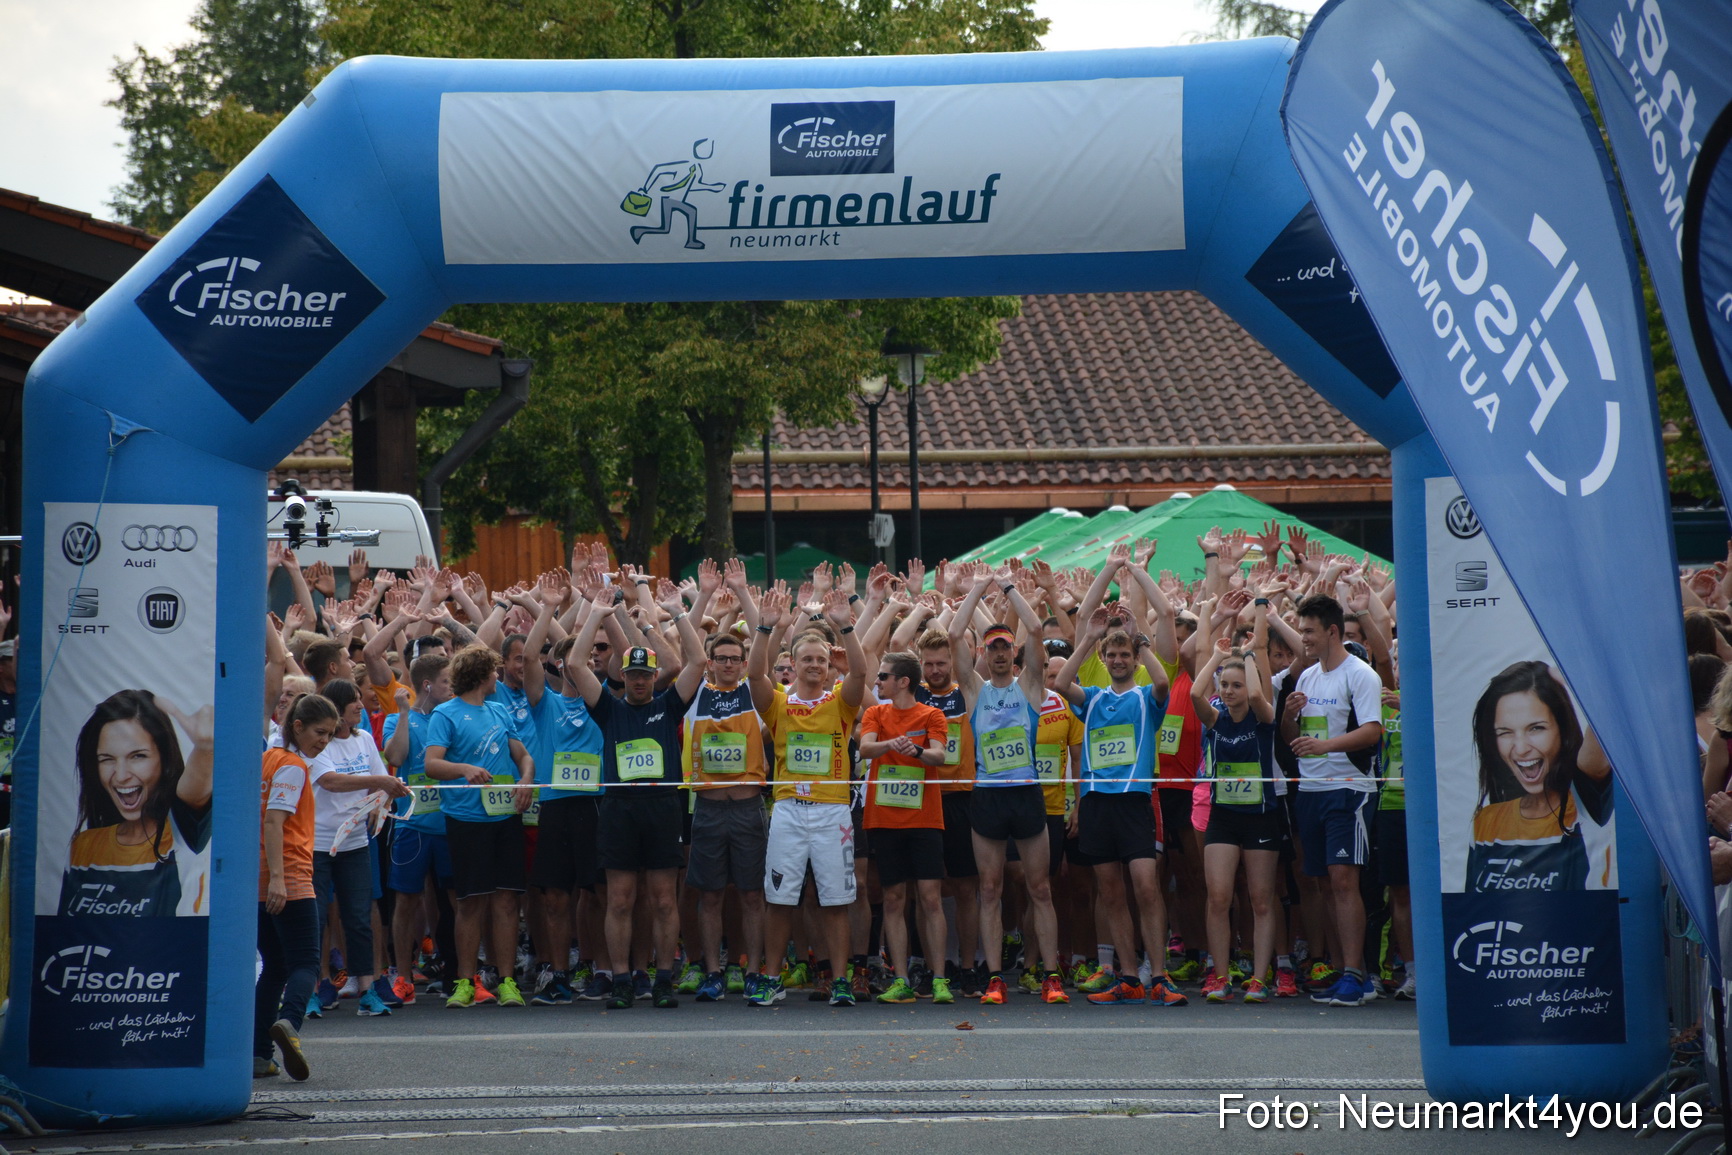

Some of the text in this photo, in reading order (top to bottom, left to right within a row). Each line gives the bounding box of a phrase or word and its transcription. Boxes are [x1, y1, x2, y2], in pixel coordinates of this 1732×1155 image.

[797, 130, 886, 148] Fischer
[805, 148, 879, 159] AUTOMOBILE
[728, 173, 1000, 228] firmenlauf
[729, 230, 841, 248] neumarkt
[1297, 257, 1335, 280] und
[197, 283, 347, 311] Fischer
[209, 314, 334, 328] AUTOMOBILE
[124, 558, 157, 568] Audi
[149, 600, 176, 621] FIAT
[1446, 597, 1500, 608] SEAT
[58, 624, 110, 634] SEAT
[787, 708, 812, 717] MAX
[705, 748, 742, 763] 1623
[794, 748, 821, 763] 891
[987, 742, 1025, 761] 1336
[1098, 741, 1126, 757] 522
[626, 753, 654, 769] 708
[561, 767, 591, 781] 810
[881, 781, 919, 797] 1028
[1224, 780, 1252, 793] 372
[488, 790, 511, 805] 813
[1476, 941, 1595, 966] Fischer
[61, 966, 181, 989] Fischer
[1486, 968, 1586, 979] AUTOMOBILE
[70, 993, 170, 1003] AUTOMOBILE
[1507, 992, 1532, 1007] und
[1536, 989, 1562, 1002] das
[1541, 1001, 1609, 1023] fährt mit!
[89, 1017, 114, 1030] und
[117, 1013, 142, 1027] das
[121, 1025, 191, 1047] fährt mit!
